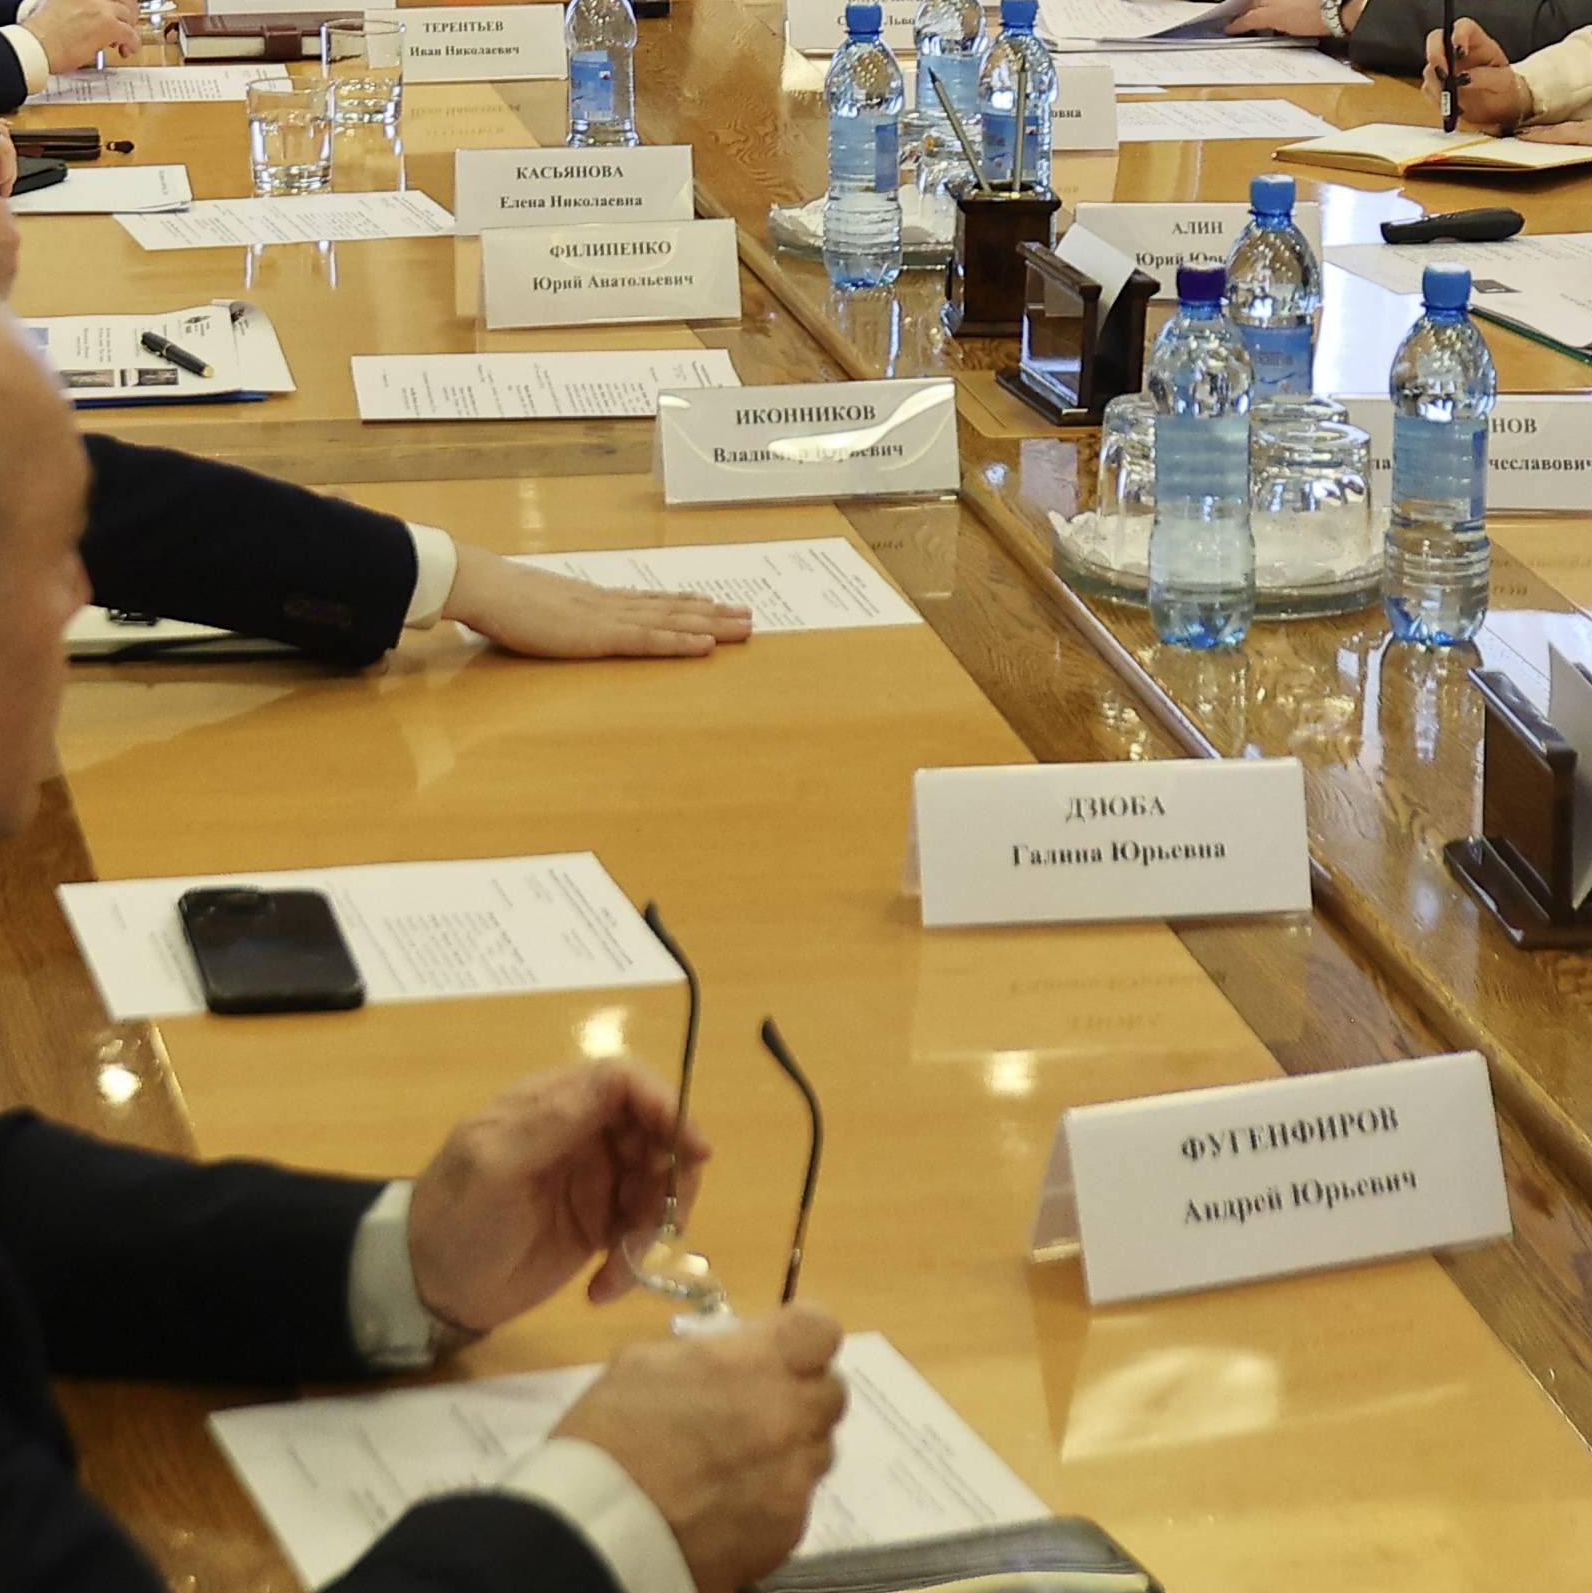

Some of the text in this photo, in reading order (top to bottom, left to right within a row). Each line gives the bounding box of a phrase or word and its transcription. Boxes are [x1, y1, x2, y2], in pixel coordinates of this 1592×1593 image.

[422, 21, 504, 33] ТЕРЕНТЬЕВ
[410, 45, 520, 57] Иван Николаевич
[516, 165, 624, 180] КАСЬЯНОВА
[500, 195, 643, 209] Елена Николаевна
[1172, 221, 1223, 235] АЛИН
[549, 241, 672, 258] ФИЛИПЕНКО
[533, 275, 693, 294] Юрий Анатольевич
[736, 405, 876, 425] ИКОННИКОВ
[1065, 796, 1166, 822] ДЗЮБА
[1012, 841, 1226, 867] Галина Юрьевна
[1181, 1107, 1399, 1162] ФУГЕНФИРОВ
[1185, 1172, 1417, 1224] Андрей Юрьевич
